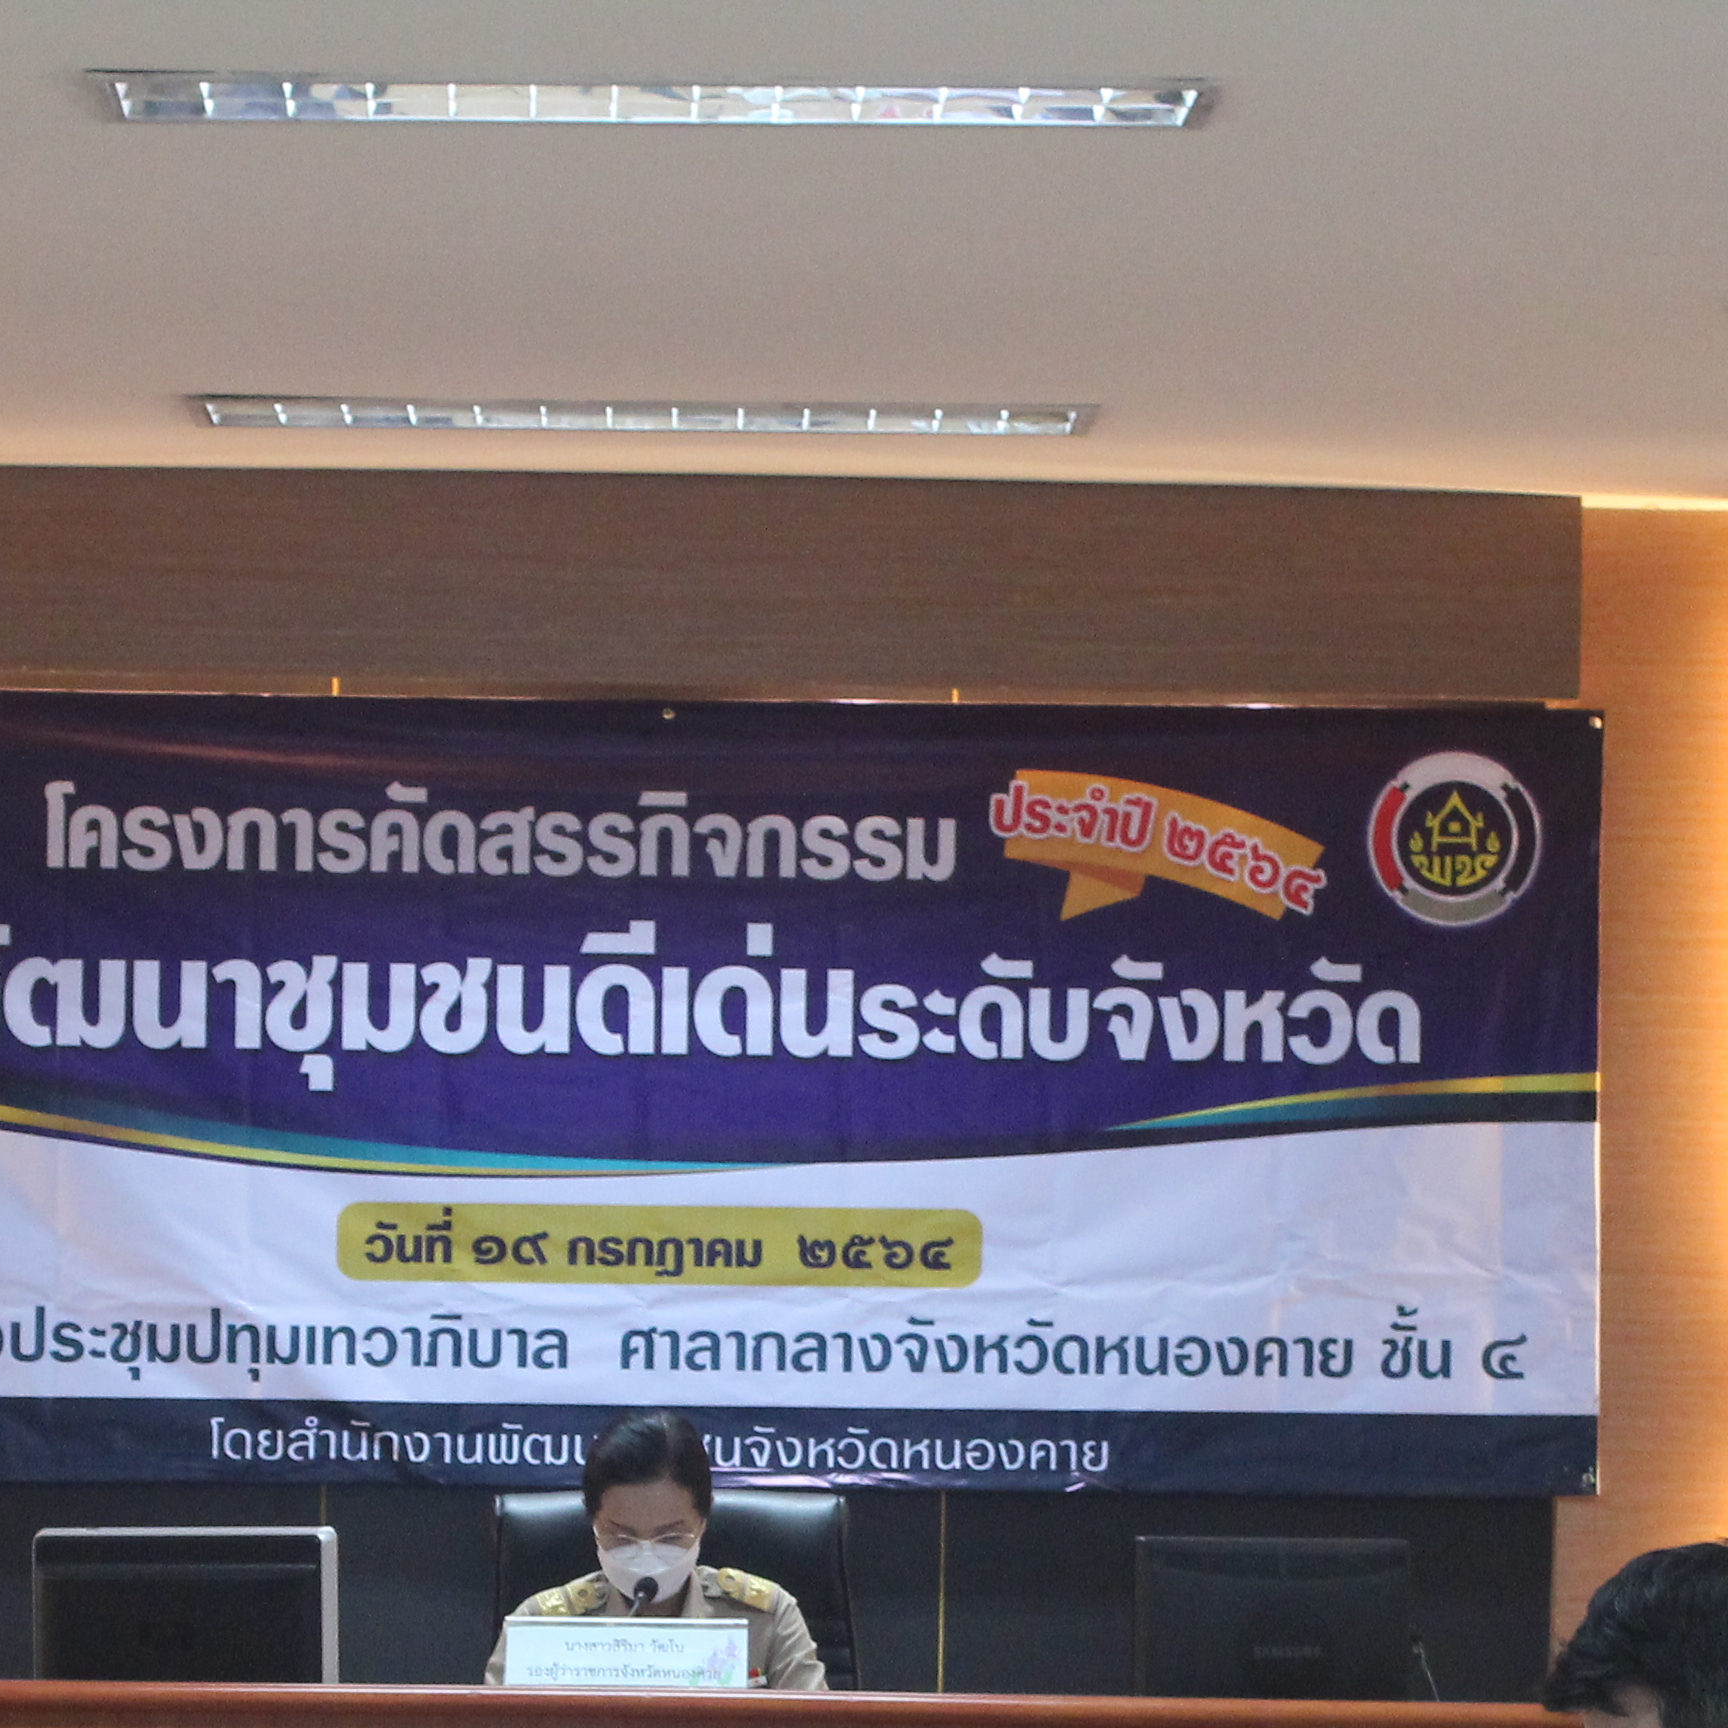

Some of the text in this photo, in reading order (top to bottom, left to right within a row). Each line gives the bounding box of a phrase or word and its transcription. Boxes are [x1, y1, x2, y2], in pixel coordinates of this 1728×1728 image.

[45, 781, 956, 881] โครงการคัดสรรกิจกรรม
[990, 780, 1326, 916] ประจำปี ๒๕๖๔
[364, 1207, 954, 1277] วันที่ ๑๙ กรกฎาคม ๒๕๖๔
[621, 1317, 1353, 1377] ศาลากลางจังหวัดหนองคาย
[1381, 1305, 1452, 1380] ชั้น
[1482, 1333, 1527, 1380] ๔
